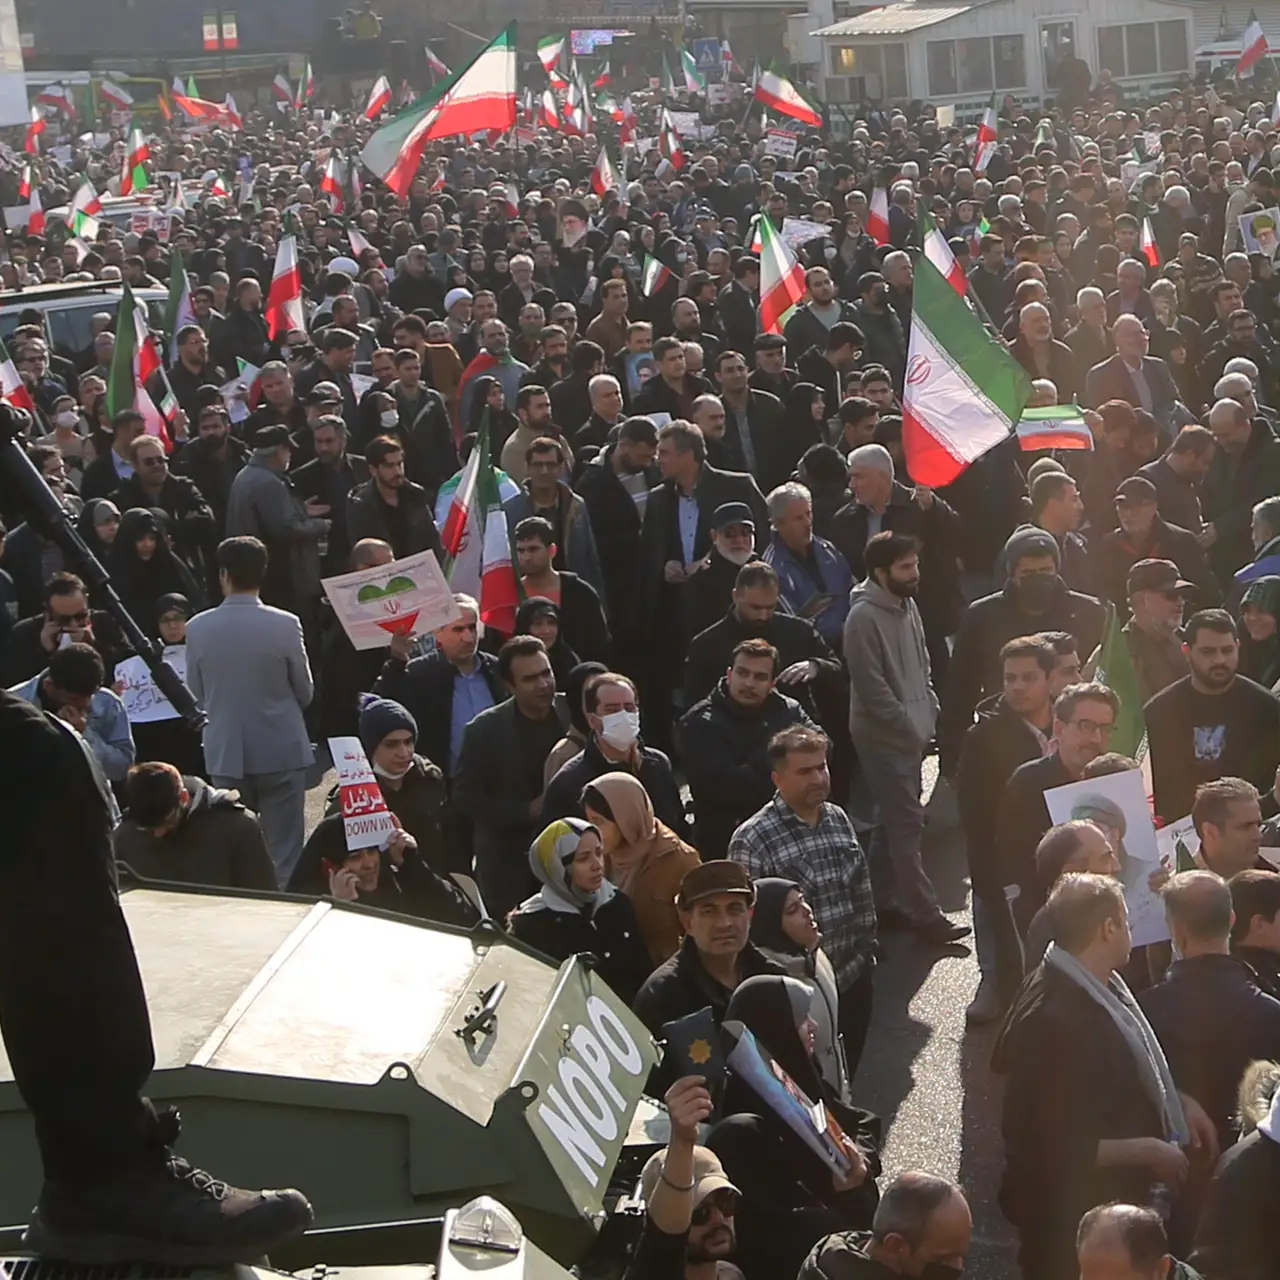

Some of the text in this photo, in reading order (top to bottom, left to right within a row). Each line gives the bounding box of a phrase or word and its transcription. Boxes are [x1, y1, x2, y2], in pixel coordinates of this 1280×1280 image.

[343, 786, 389, 815] سرائیل
[346, 820, 378, 837] DOWN
[538, 995, 643, 1188] NOPO
